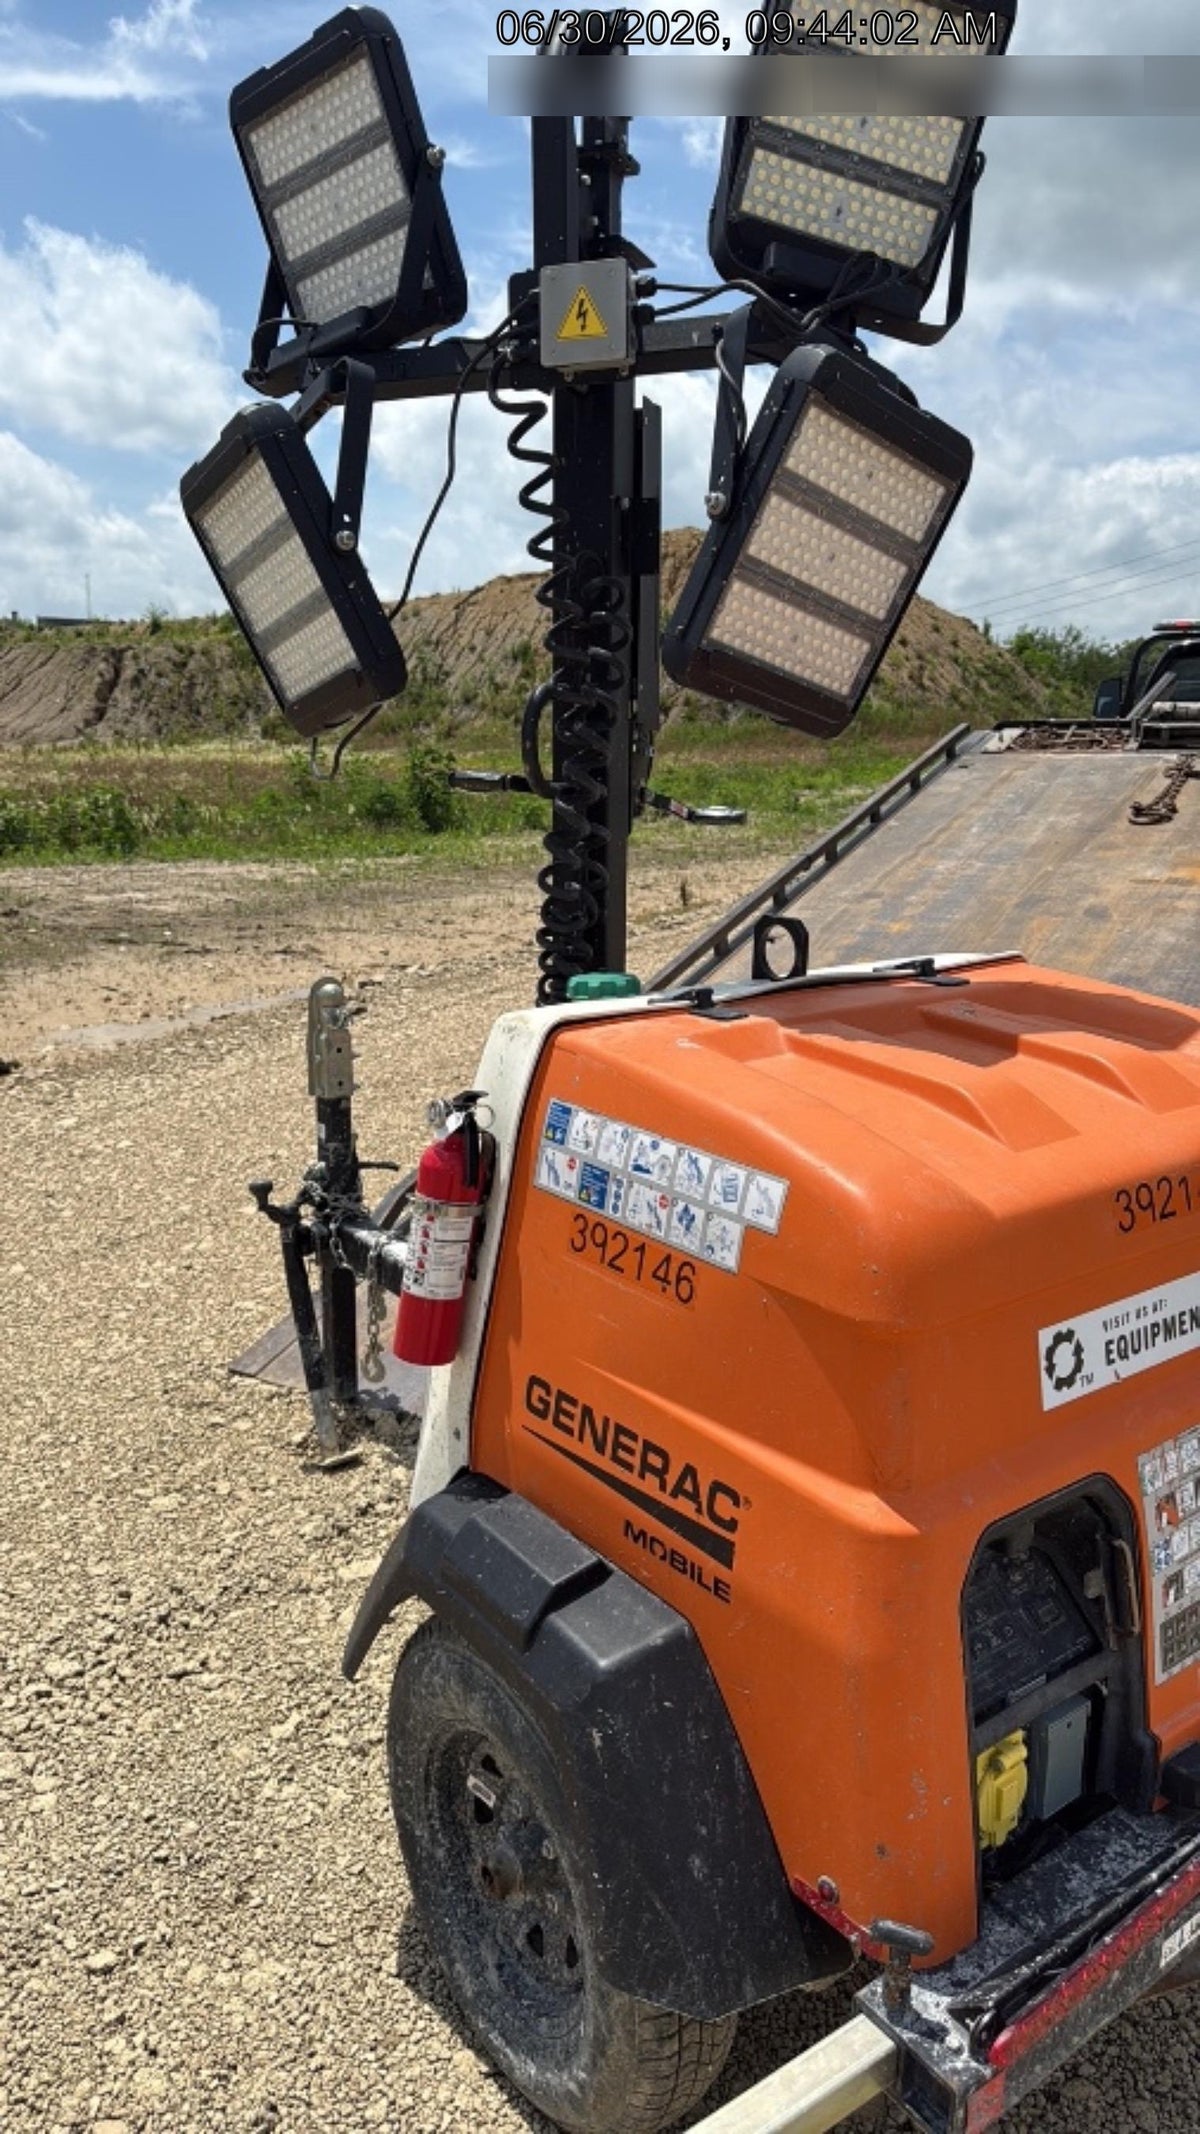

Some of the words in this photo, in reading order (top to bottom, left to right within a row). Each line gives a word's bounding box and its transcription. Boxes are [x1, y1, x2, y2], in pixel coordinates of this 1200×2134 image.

[1115, 1176, 1200, 1233] 3921
[570, 1213, 696, 1304] 392146
[1102, 1311, 1130, 1333] VISIT
[1079, 1371, 1094, 1388] TM
[525, 1374, 741, 1534] GENERAC
[623, 1518, 732, 1604] MOBILE
